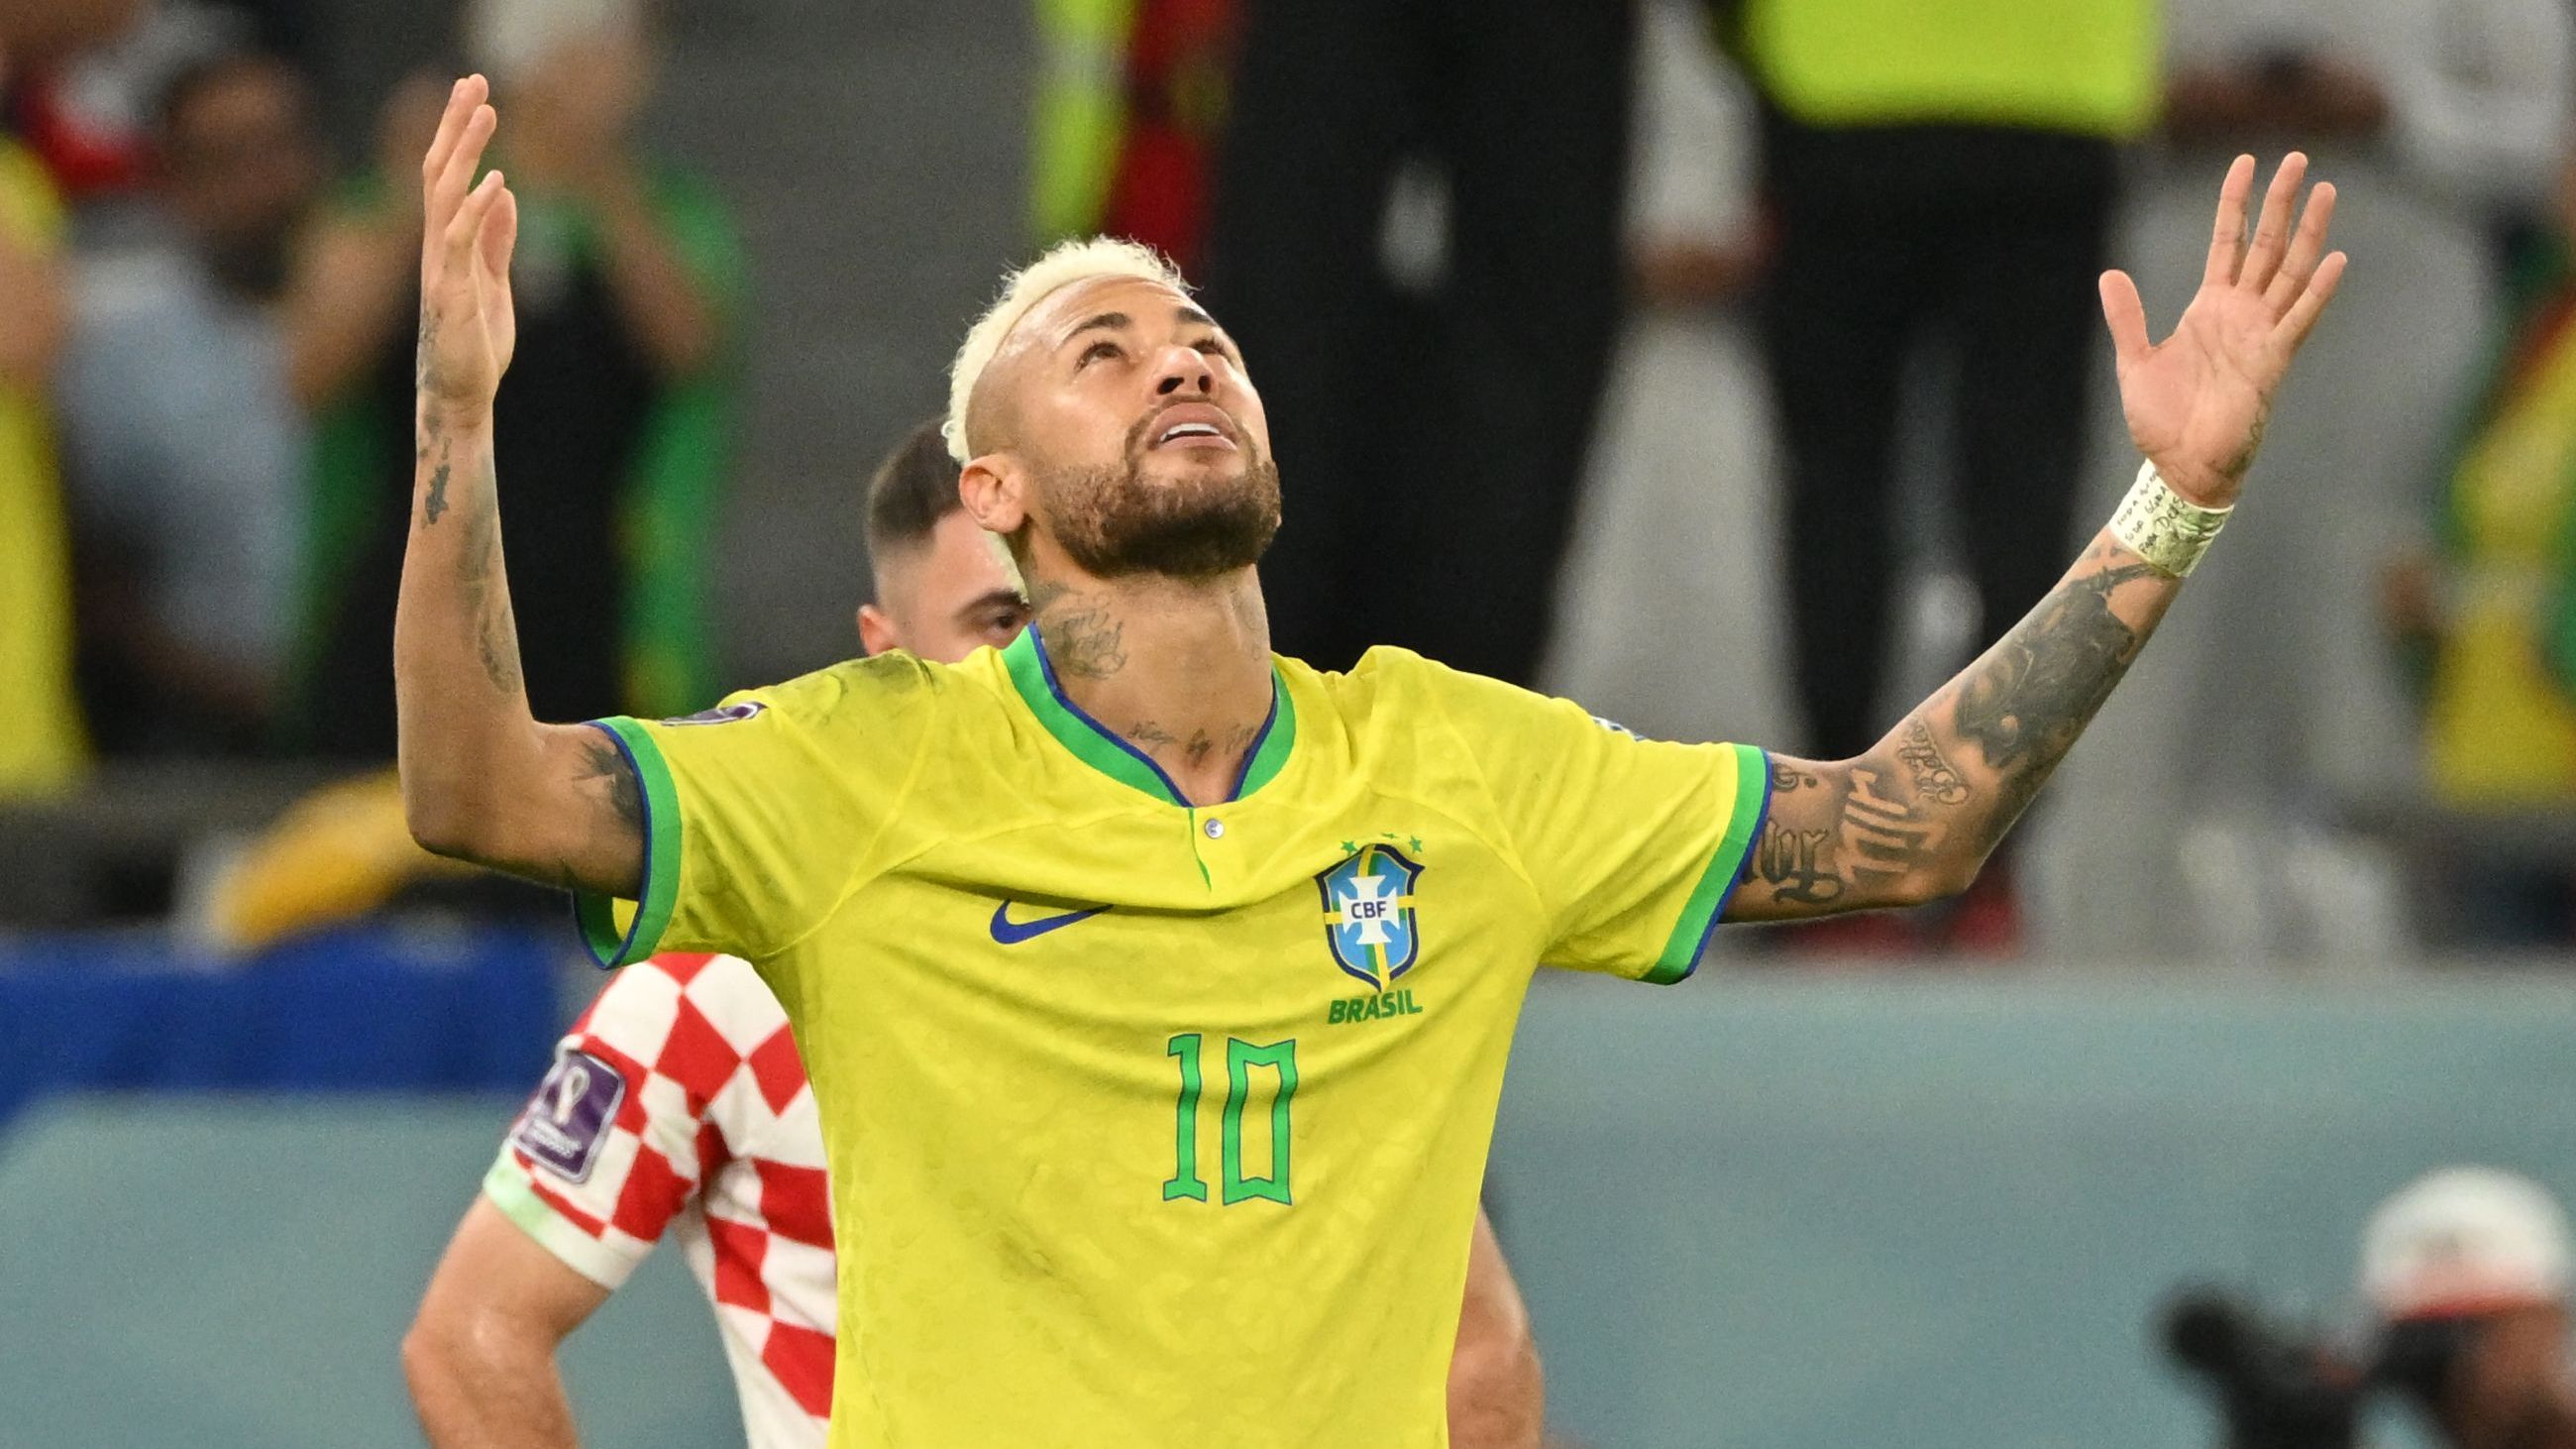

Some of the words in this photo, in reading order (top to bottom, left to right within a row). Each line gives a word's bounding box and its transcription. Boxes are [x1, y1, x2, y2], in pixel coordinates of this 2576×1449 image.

[1350, 900, 1387, 920] CBF
[1327, 989, 1424, 1025] BRASIL
[1162, 1033, 1299, 1206] 10
